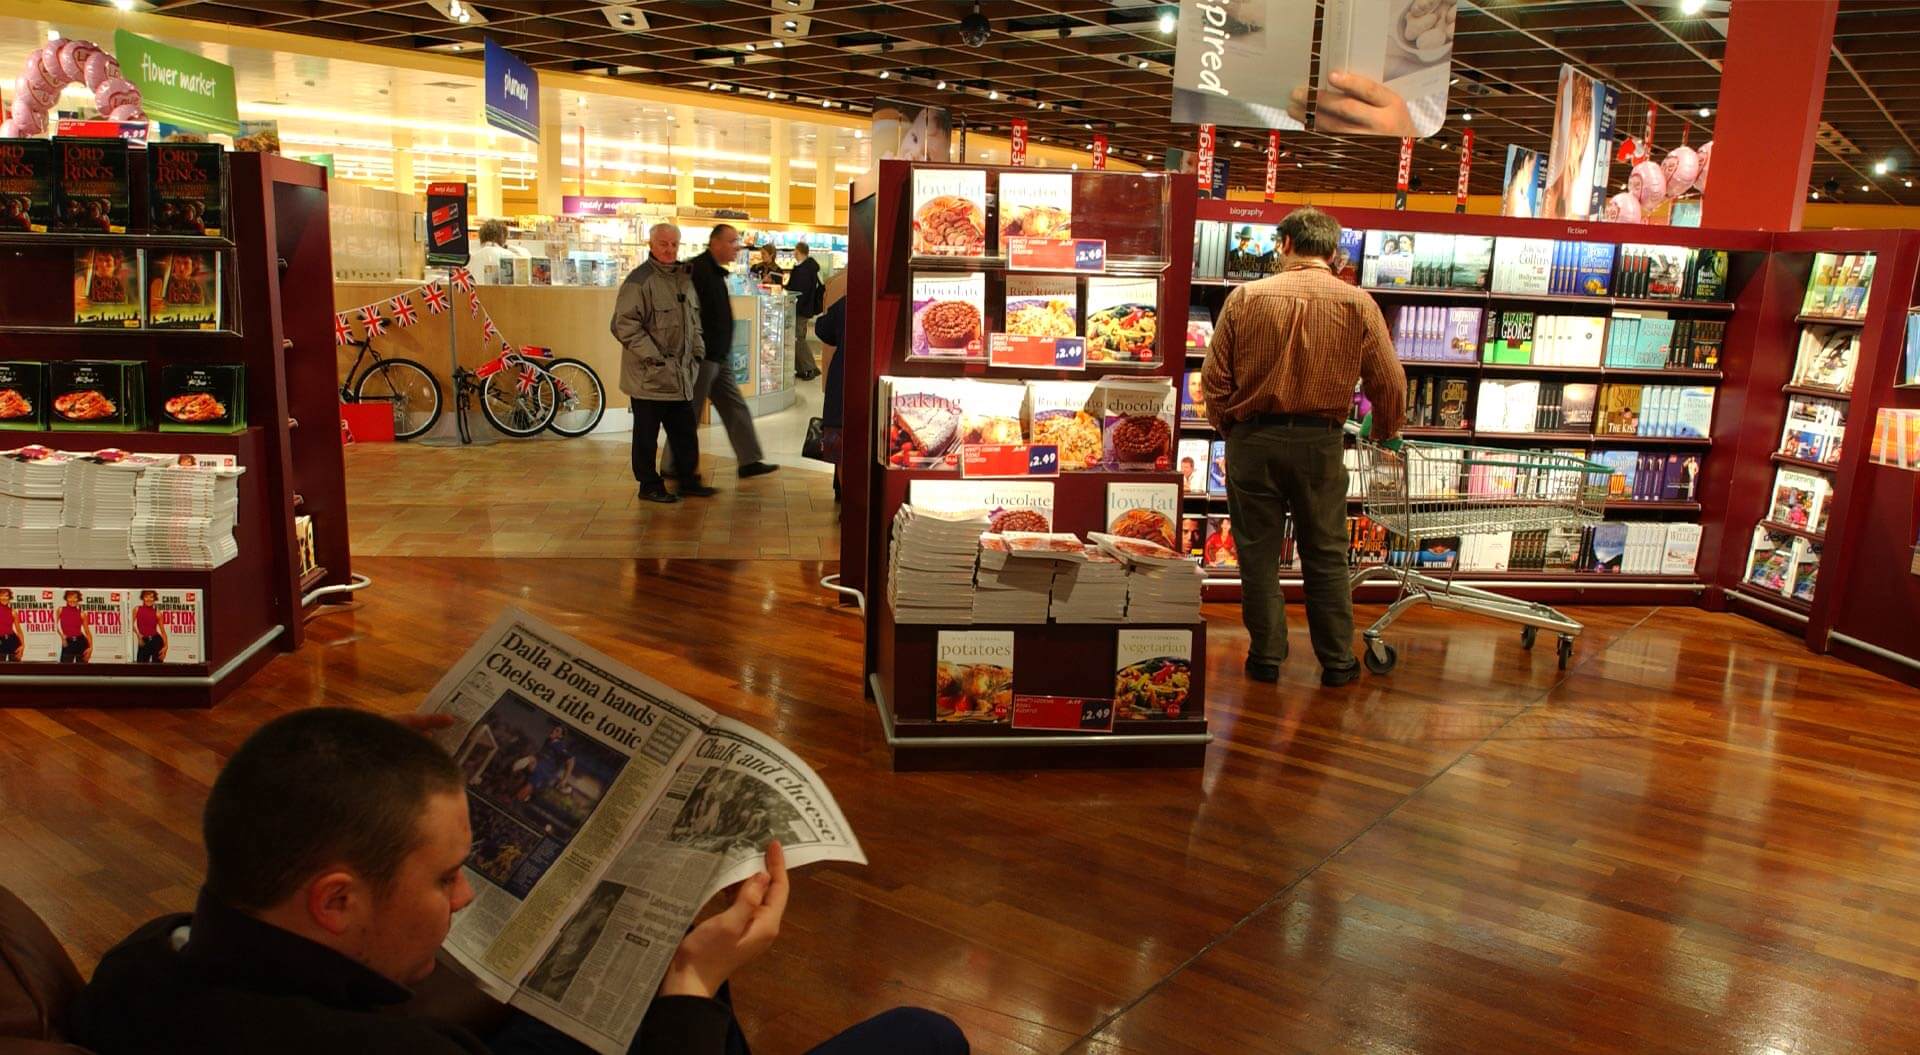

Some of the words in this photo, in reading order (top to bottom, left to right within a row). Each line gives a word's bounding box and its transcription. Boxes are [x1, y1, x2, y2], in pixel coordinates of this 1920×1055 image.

[1198, 0, 1230, 96] pired
[142, 52, 178, 86] flower
[180, 72, 217, 98] market
[1012, 125, 1024, 166] ega
[1398, 136, 1410, 184] meg
[64, 163, 114, 182] RINGS
[157, 166, 207, 184] RINGS
[917, 178, 945, 196] low
[1229, 207, 1264, 217] biography
[1567, 226, 1588, 236] fiction
[1501, 322, 1532, 340] GEORGE
[894, 390, 961, 416] baking
[1108, 398, 1173, 413] chocolate
[1608, 423, 1621, 433] THE
[1622, 423, 1636, 433] KISS
[983, 493, 1050, 507] chocolate
[1111, 492, 1145, 511] low
[1149, 493, 1175, 511] fat
[18, 610, 55, 624] DETOX
[87, 611, 121, 626] DETOX
[163, 611, 196, 625] DETOX
[27, 624, 40, 633] FOR
[41, 623, 55, 632] LIFE
[95, 625, 109, 634] FOR
[109, 625, 122, 635] LIFE
[170, 625, 182, 634] FOR
[183, 625, 196, 634] LIFE
[941, 642, 1011, 659] potatoes
[1122, 641, 1187, 656] vegetarian
[502, 632, 552, 672] Dalla
[552, 660, 601, 699] Bona
[603, 686, 657, 727] hands
[486, 652, 556, 703] Chelsea
[556, 693, 593, 725] title
[596, 716, 642, 750] tonic
[696, 737, 742, 762] Chalk
[737, 752, 783, 776] and
[775, 775, 836, 842] cheese
